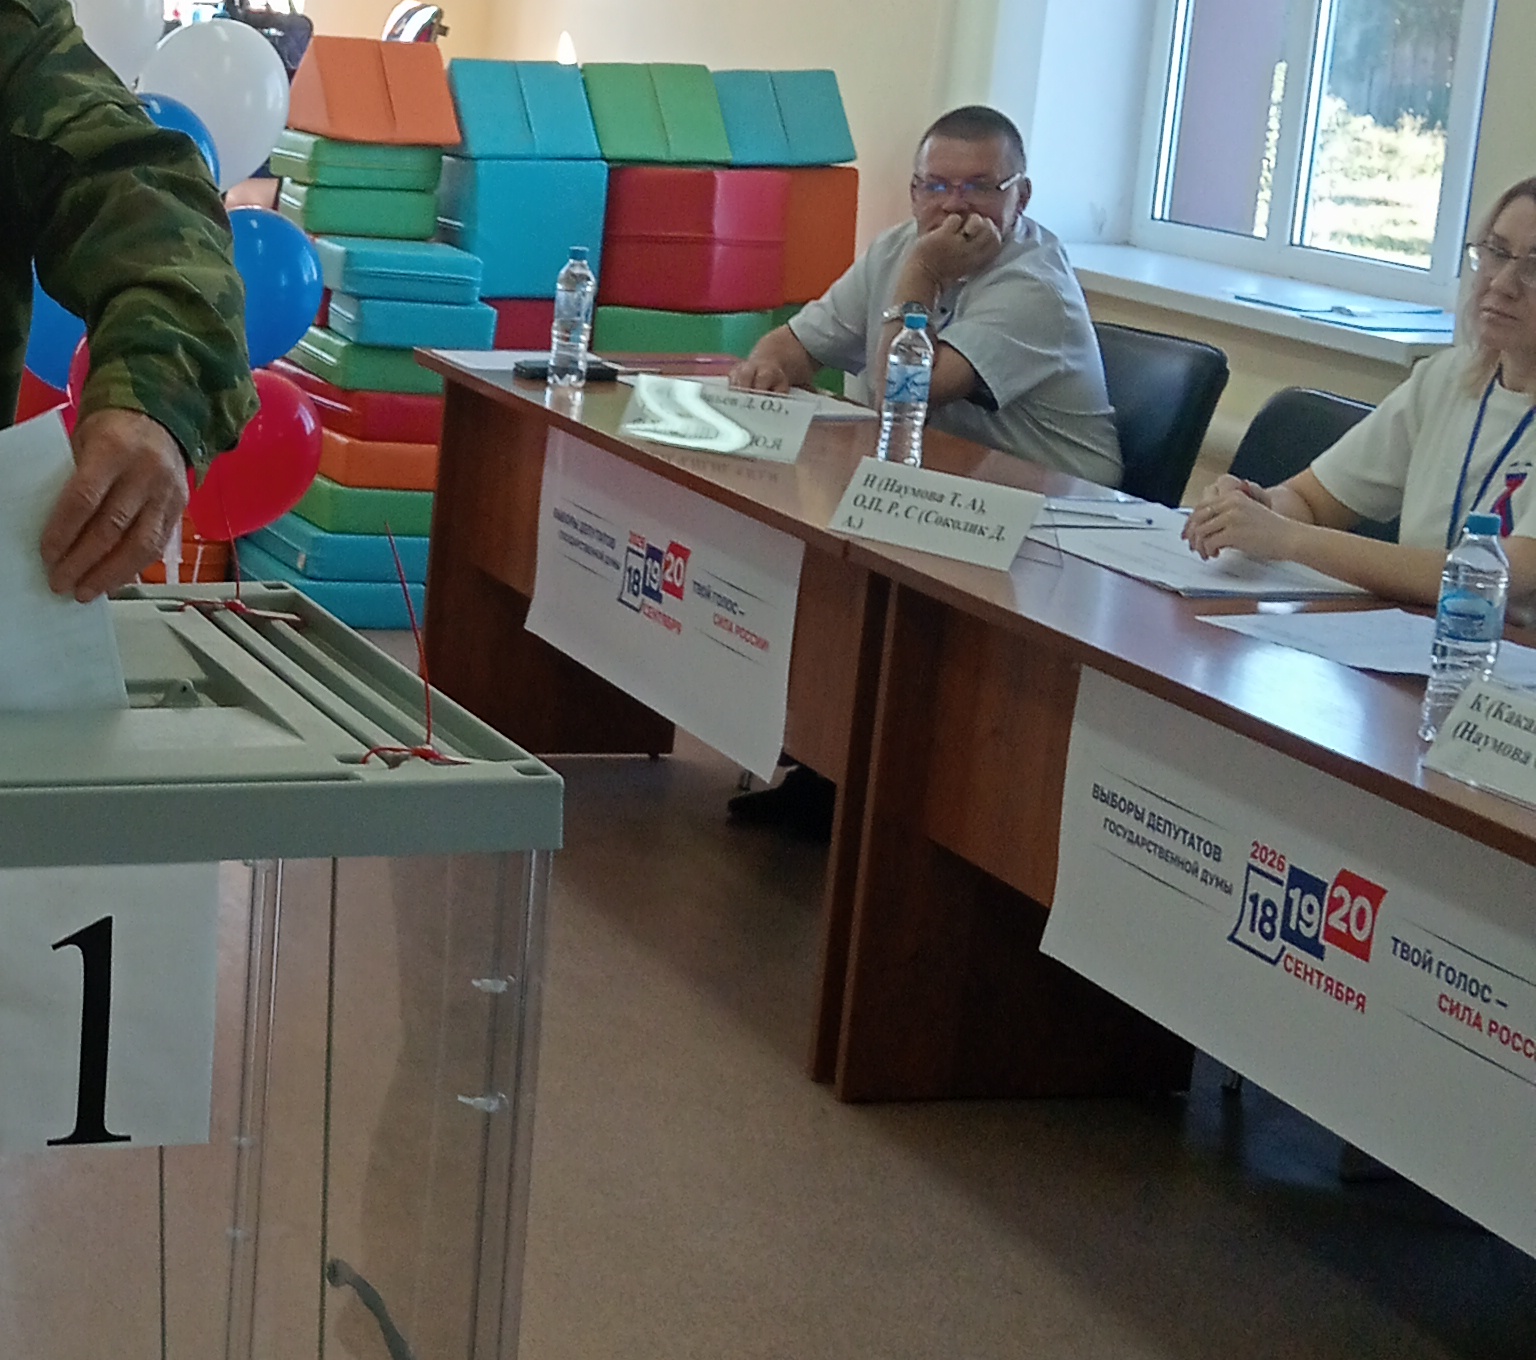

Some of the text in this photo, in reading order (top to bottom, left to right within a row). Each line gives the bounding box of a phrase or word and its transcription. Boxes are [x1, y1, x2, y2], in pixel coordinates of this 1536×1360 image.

[626, 552, 685, 597] 18 19 20
[1092, 783, 1222, 862] ВЫБОРЫ ДЕПУТАТОВ
[1103, 817, 1233, 895] ГОСУДАРСТВЕННОЙ ДУМЫ
[1250, 840, 1286, 873] 2026
[1249, 885, 1373, 942] 18 19 20
[1283, 953, 1367, 1014] СЕНТЯБРЯ
[1391, 936, 1434, 974] ТВОЙ
[1436, 960, 1492, 1003] ГОЛОС
[47, 915, 131, 1146] 1
[1438, 994, 1536, 1062] СИЛА РОСС
